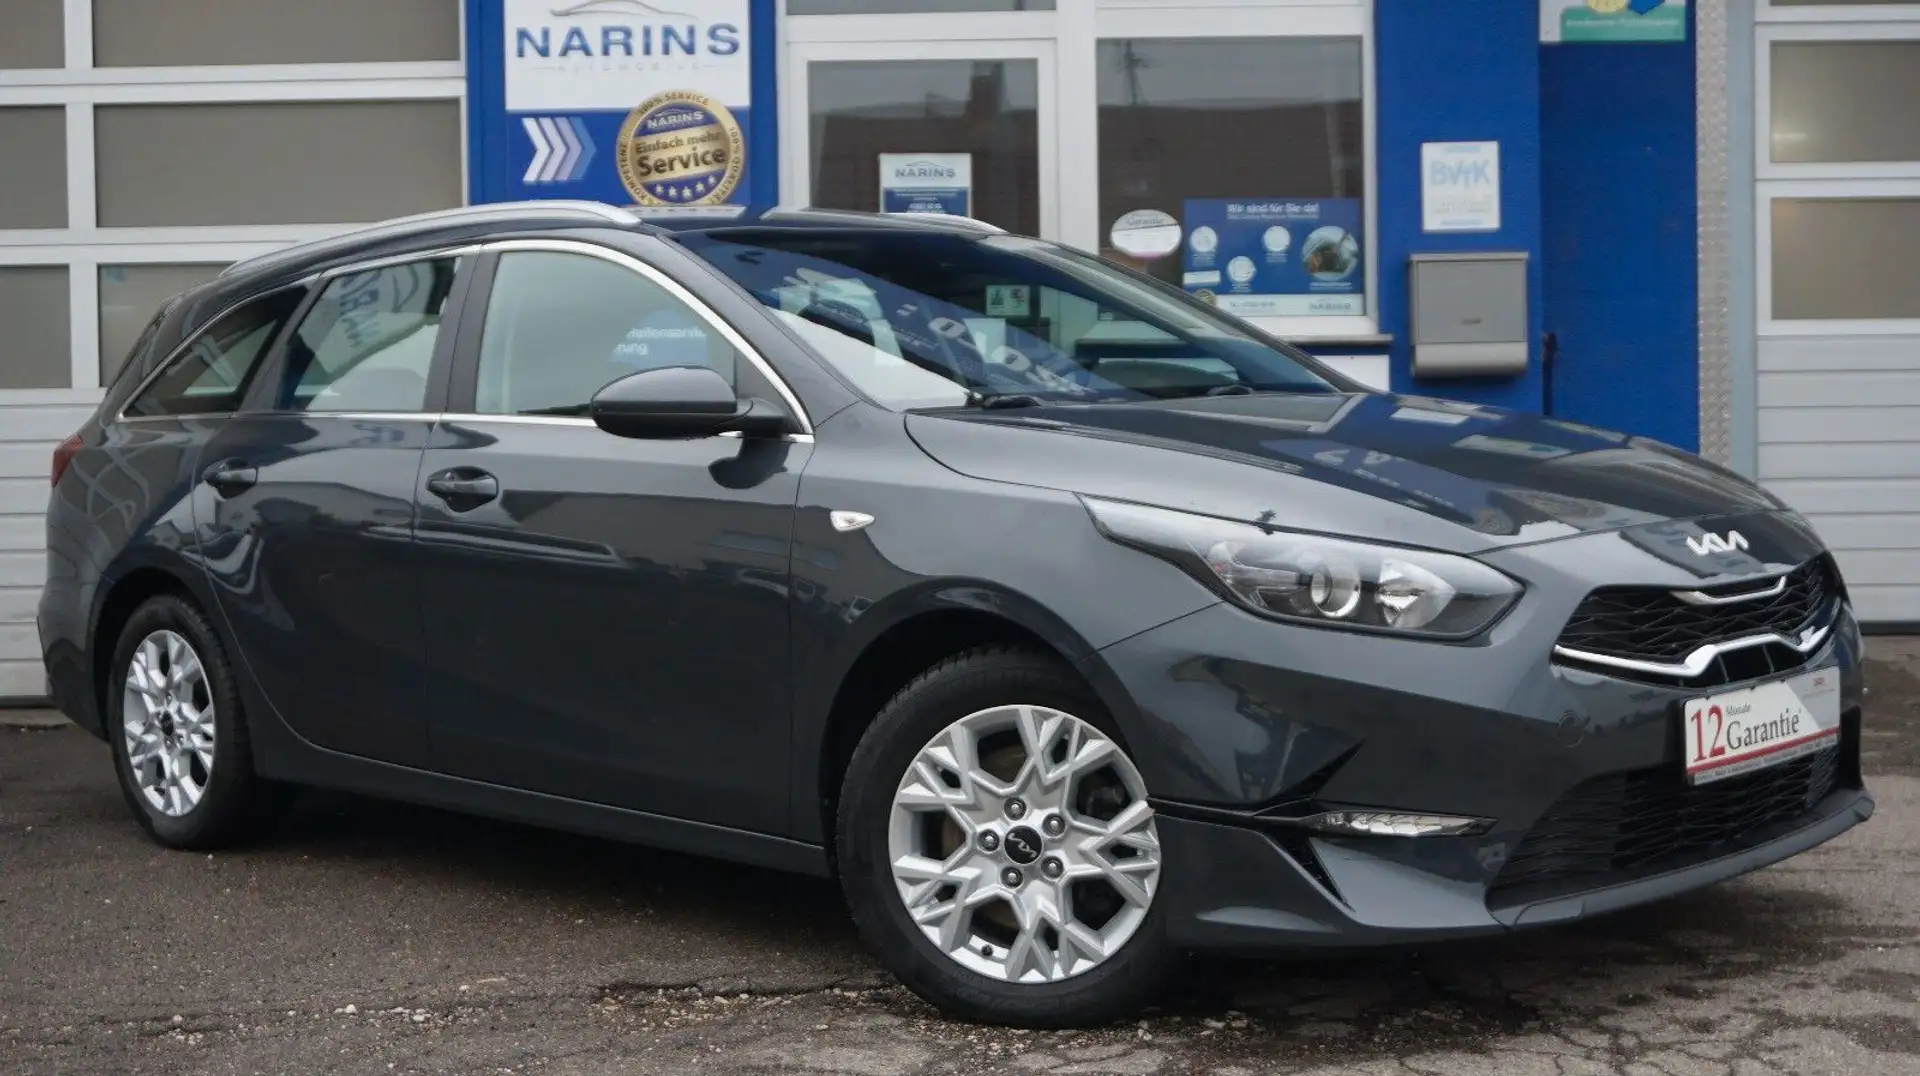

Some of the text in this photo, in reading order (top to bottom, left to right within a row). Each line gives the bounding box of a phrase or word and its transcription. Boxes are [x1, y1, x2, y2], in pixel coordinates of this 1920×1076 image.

[516, 23, 740, 57] NARINS
[647, 111, 705, 129] NARINS
[636, 136, 684, 154] Einfach
[636, 147, 726, 177] Service
[895, 167, 956, 178] NARINS
[1691, 704, 1725, 763] 12
